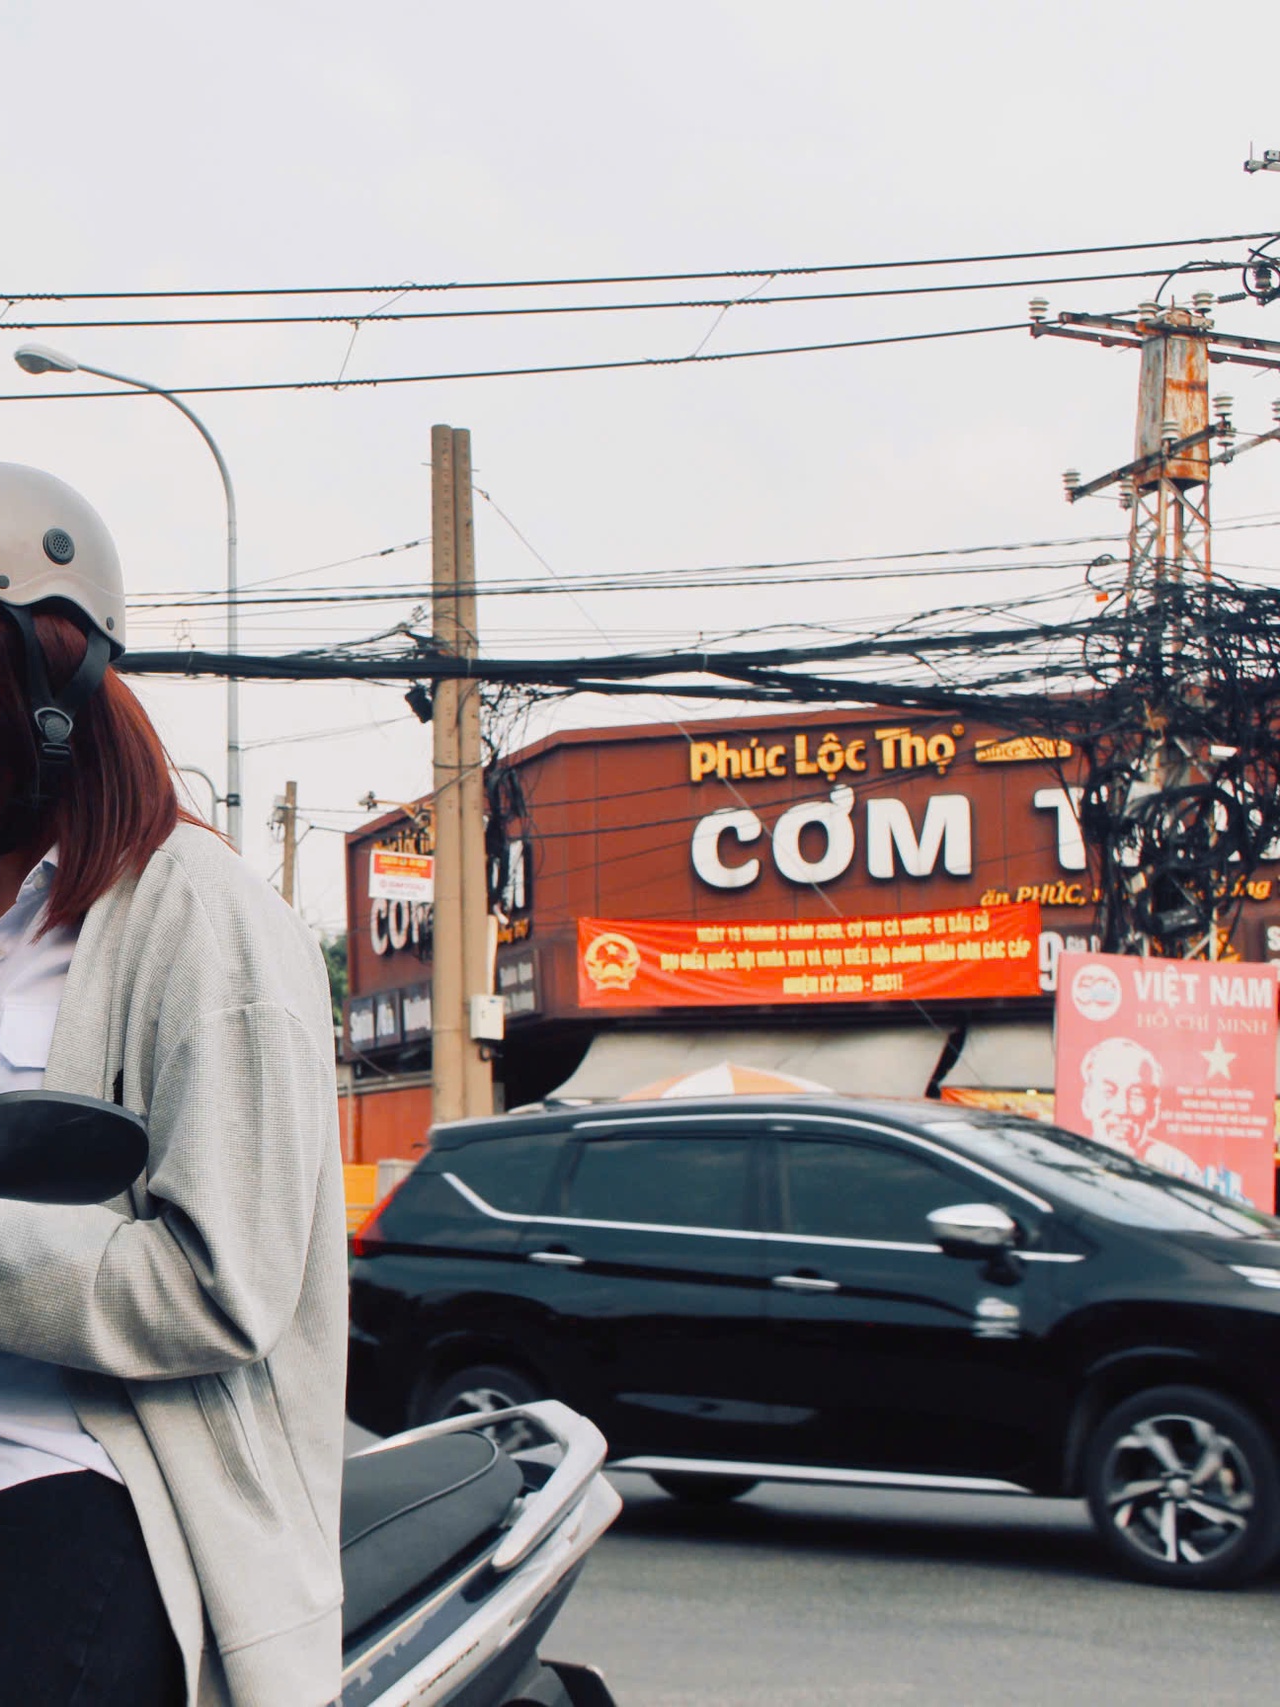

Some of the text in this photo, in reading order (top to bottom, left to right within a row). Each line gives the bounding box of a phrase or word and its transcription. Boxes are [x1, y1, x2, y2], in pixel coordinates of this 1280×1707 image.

[690, 728, 956, 782] Phúc Lộc Thọ
[691, 784, 972, 888] CƠM
[1133, 964, 1273, 1009] VIỆT NAM
[1217, 1017, 1268, 1035] MINH
